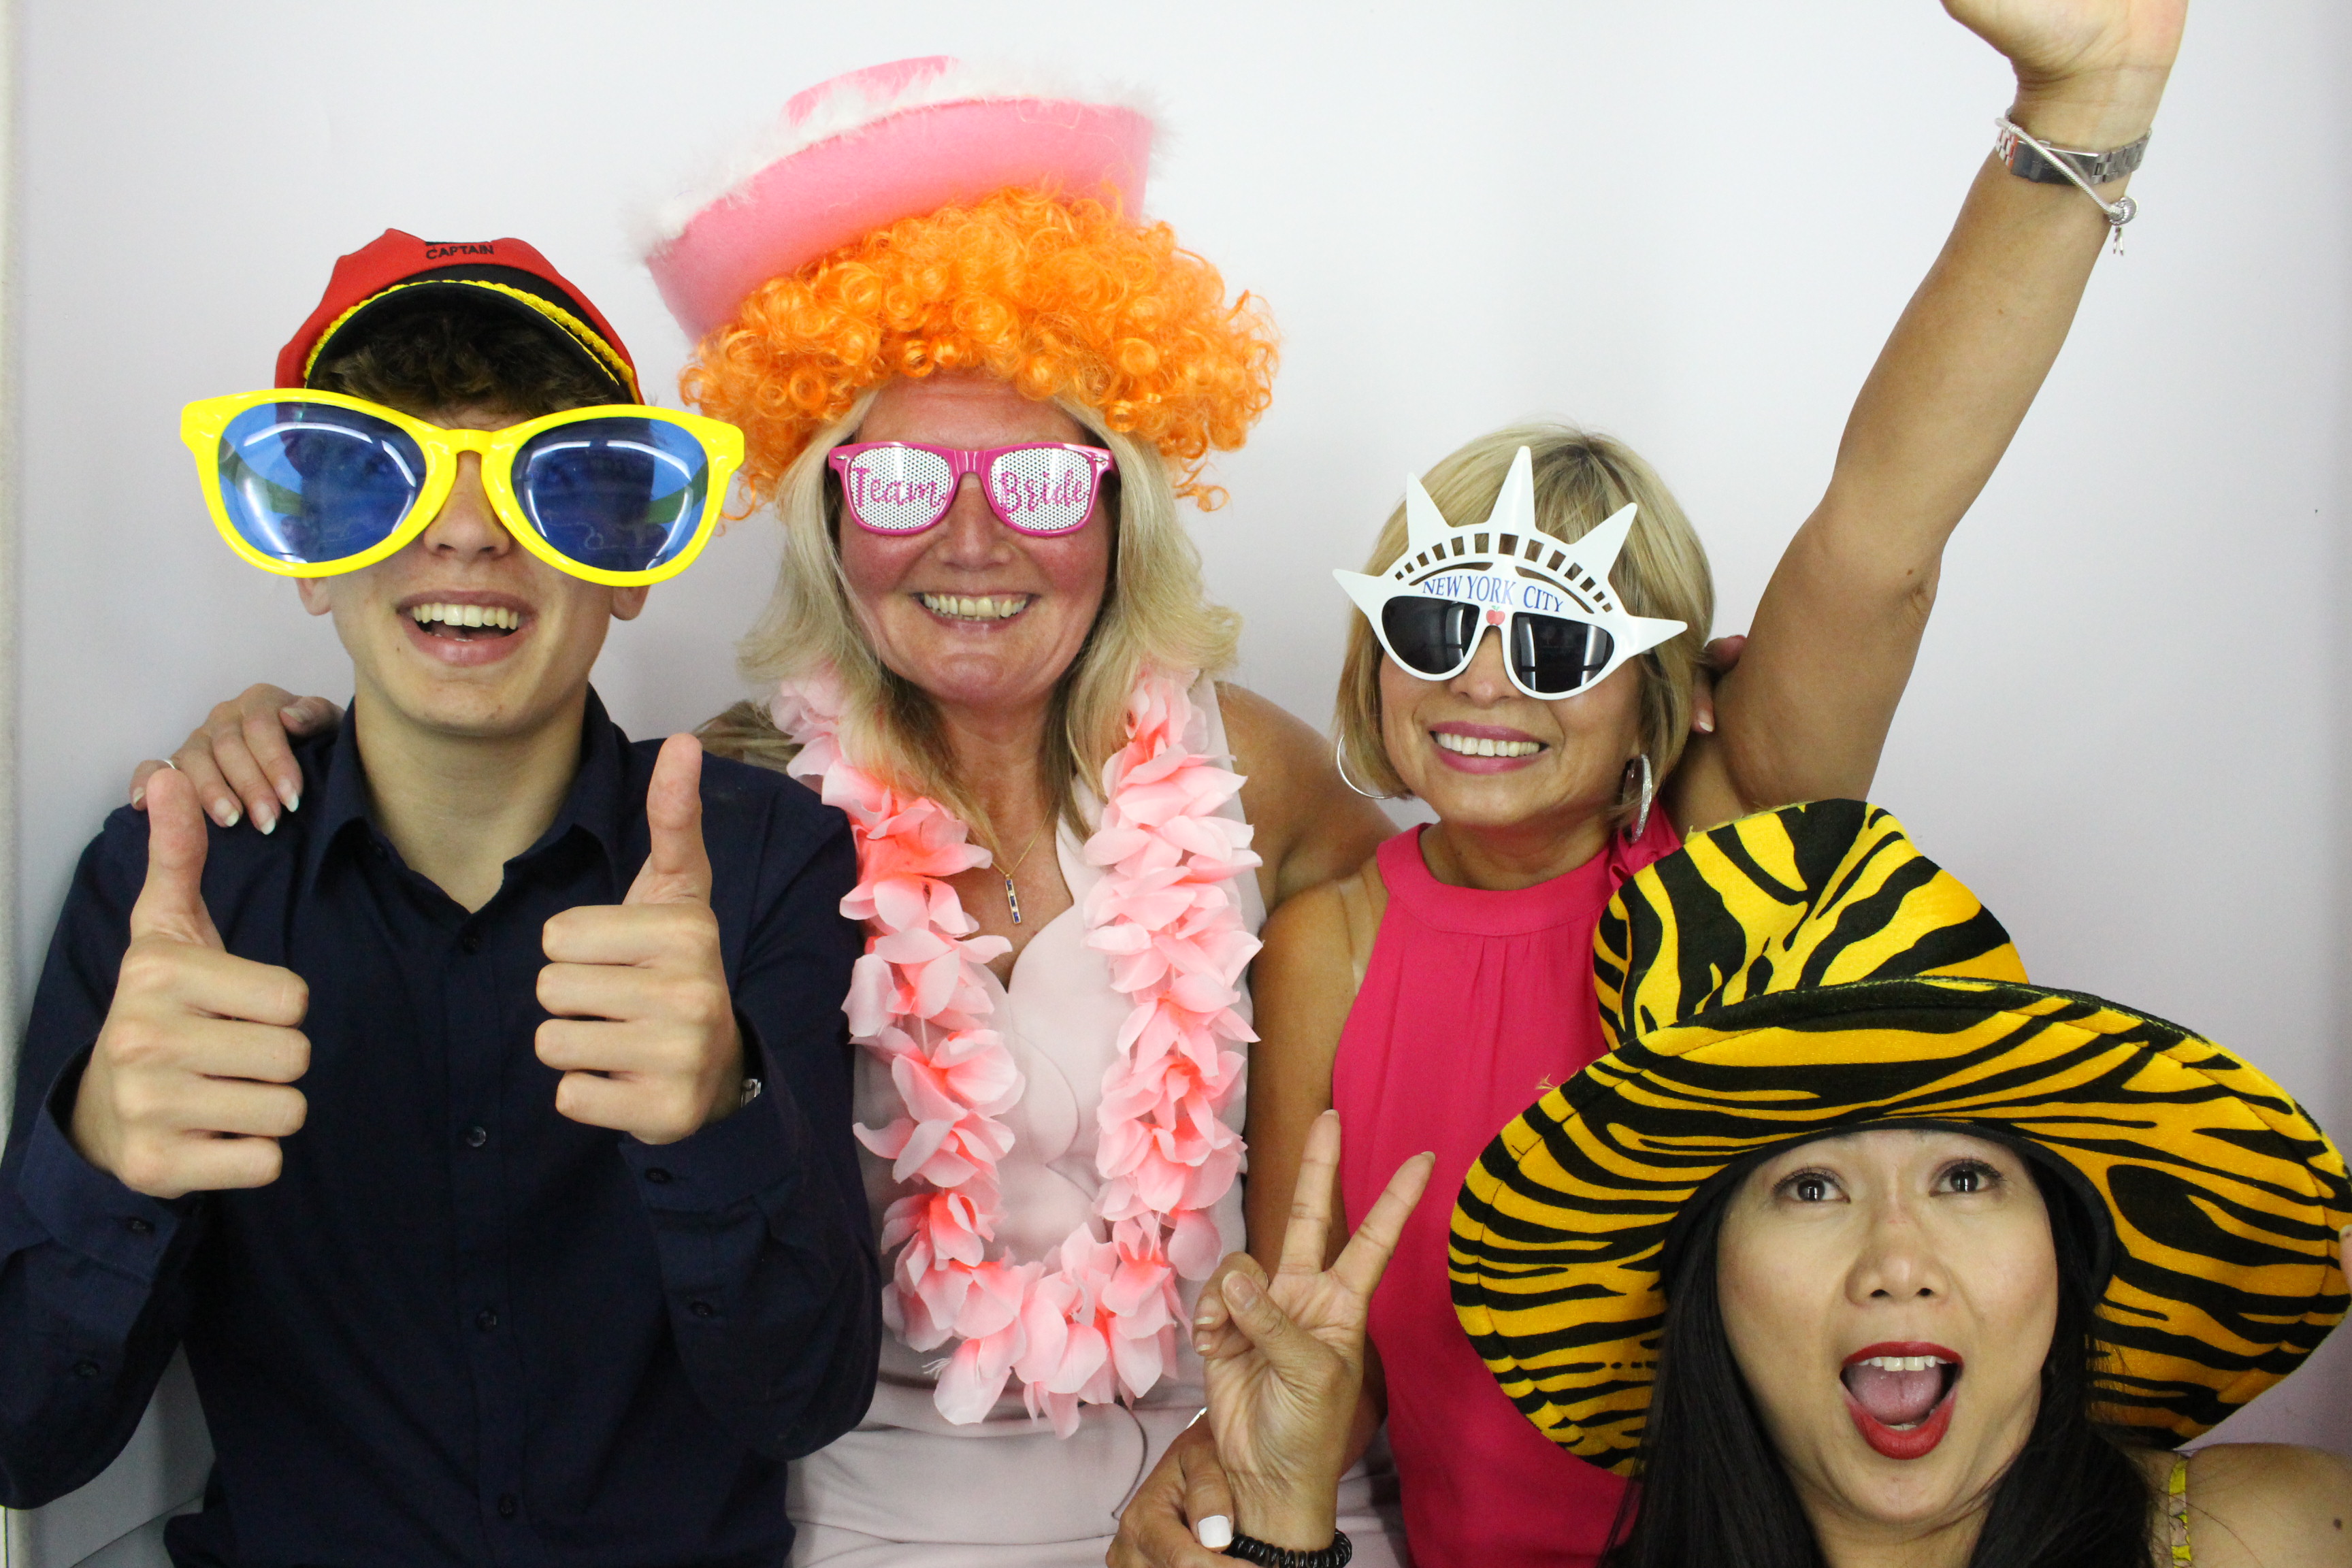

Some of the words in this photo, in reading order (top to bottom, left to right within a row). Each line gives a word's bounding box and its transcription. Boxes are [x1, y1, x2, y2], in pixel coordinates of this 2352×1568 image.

[426, 244, 494, 259] CAPTAIN
[850, 468, 947, 508] Team
[998, 469, 1090, 514] Bride
[1422, 575, 1463, 598] NEW
[1467, 575, 1517, 606] YORK
[1523, 585, 1564, 612] CITY
